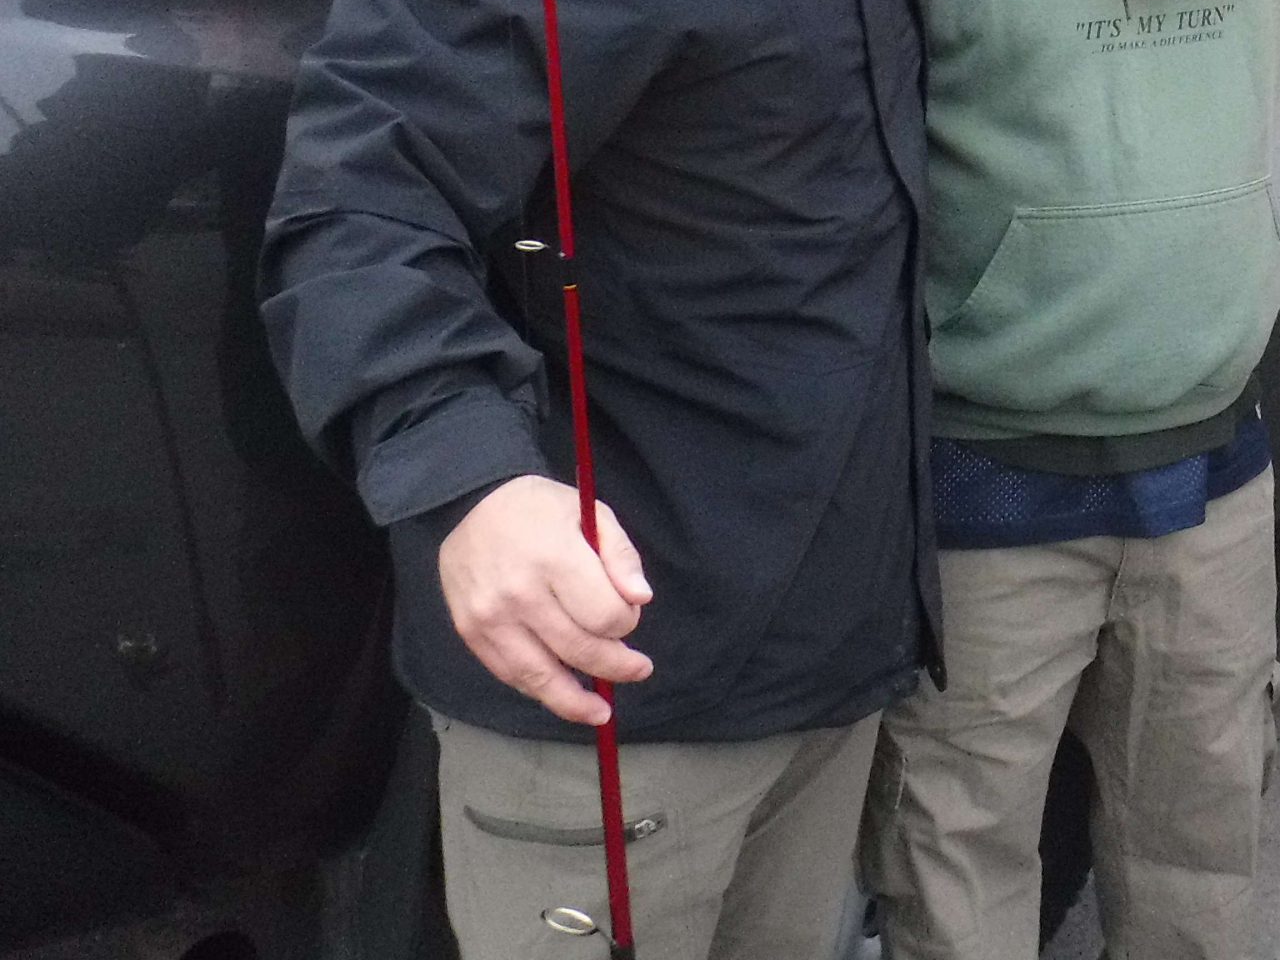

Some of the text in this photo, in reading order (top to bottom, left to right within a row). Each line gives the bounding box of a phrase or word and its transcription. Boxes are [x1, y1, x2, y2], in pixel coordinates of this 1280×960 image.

[1076, 4, 1235, 40] "IT'S MY TURN"
[1118, 40, 1146, 51] MAKE
[1160, 30, 1223, 47] DIFFERENCE
